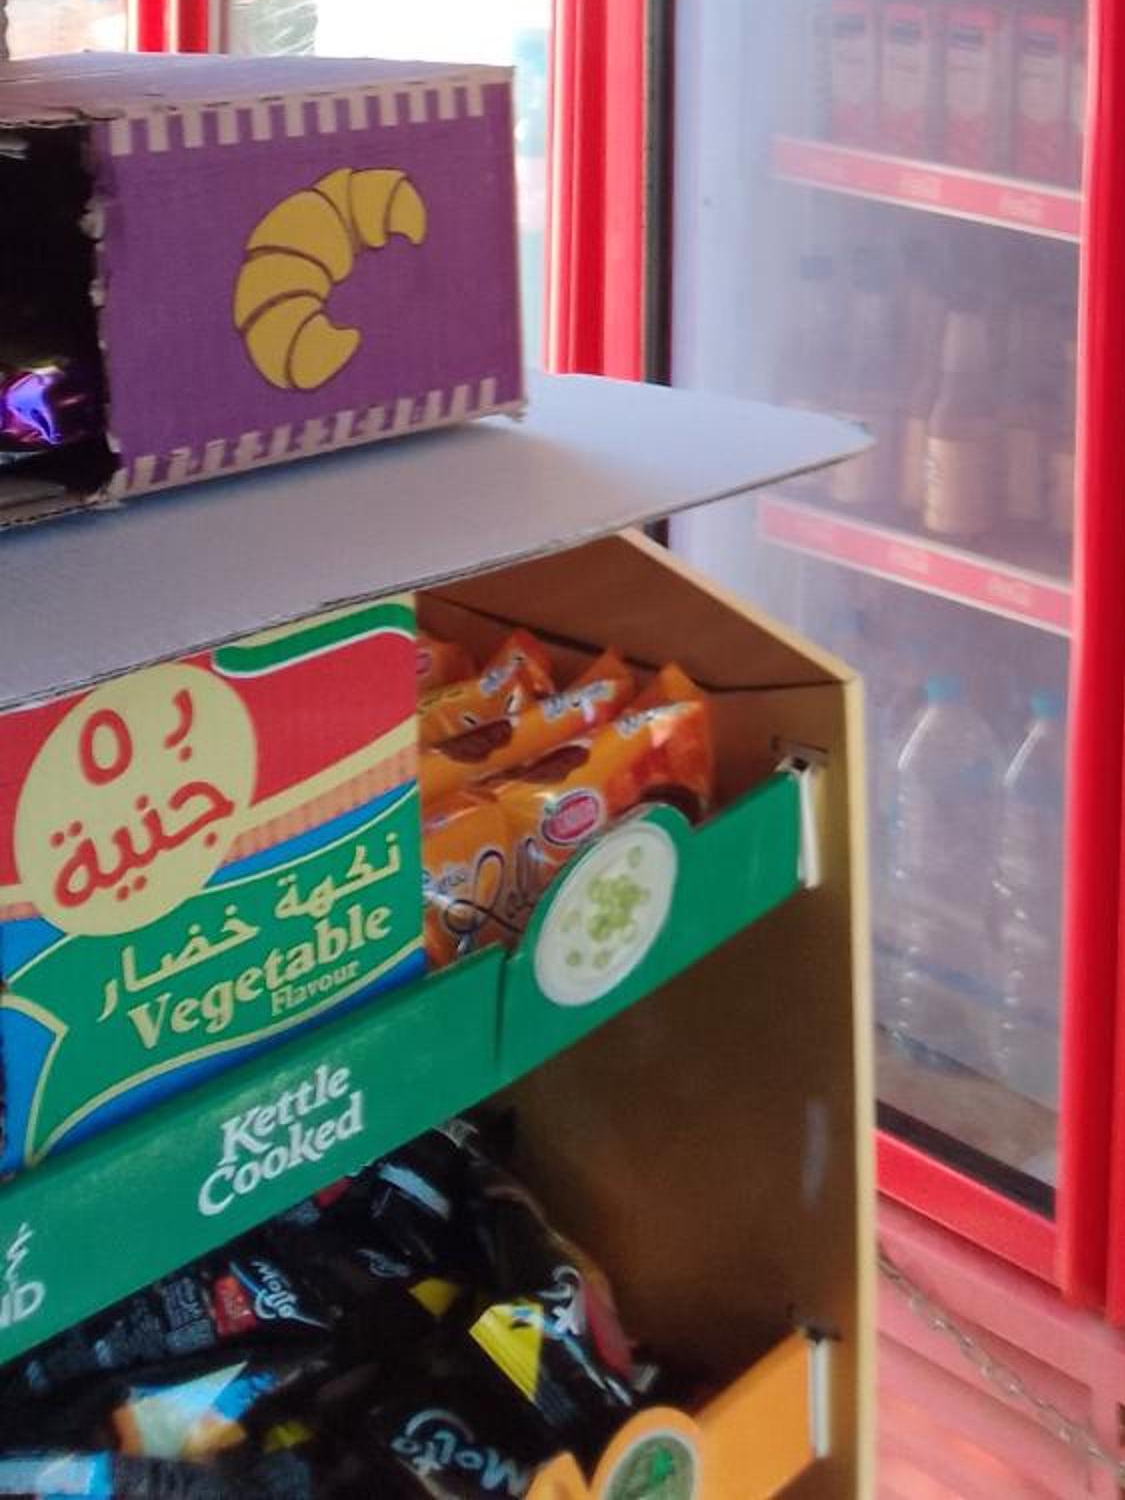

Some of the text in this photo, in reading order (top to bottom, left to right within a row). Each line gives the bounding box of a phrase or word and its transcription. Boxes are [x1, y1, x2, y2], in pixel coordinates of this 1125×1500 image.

[49, 780, 234, 909] جنية
[96, 831, 401, 1023] نكهة خضار
[127, 903, 393, 1050] Vegetable
[270, 959, 361, 1018] Flavour
[197, 1093, 364, 1217] Cooked
[219, 1063, 353, 1164] Kettle
